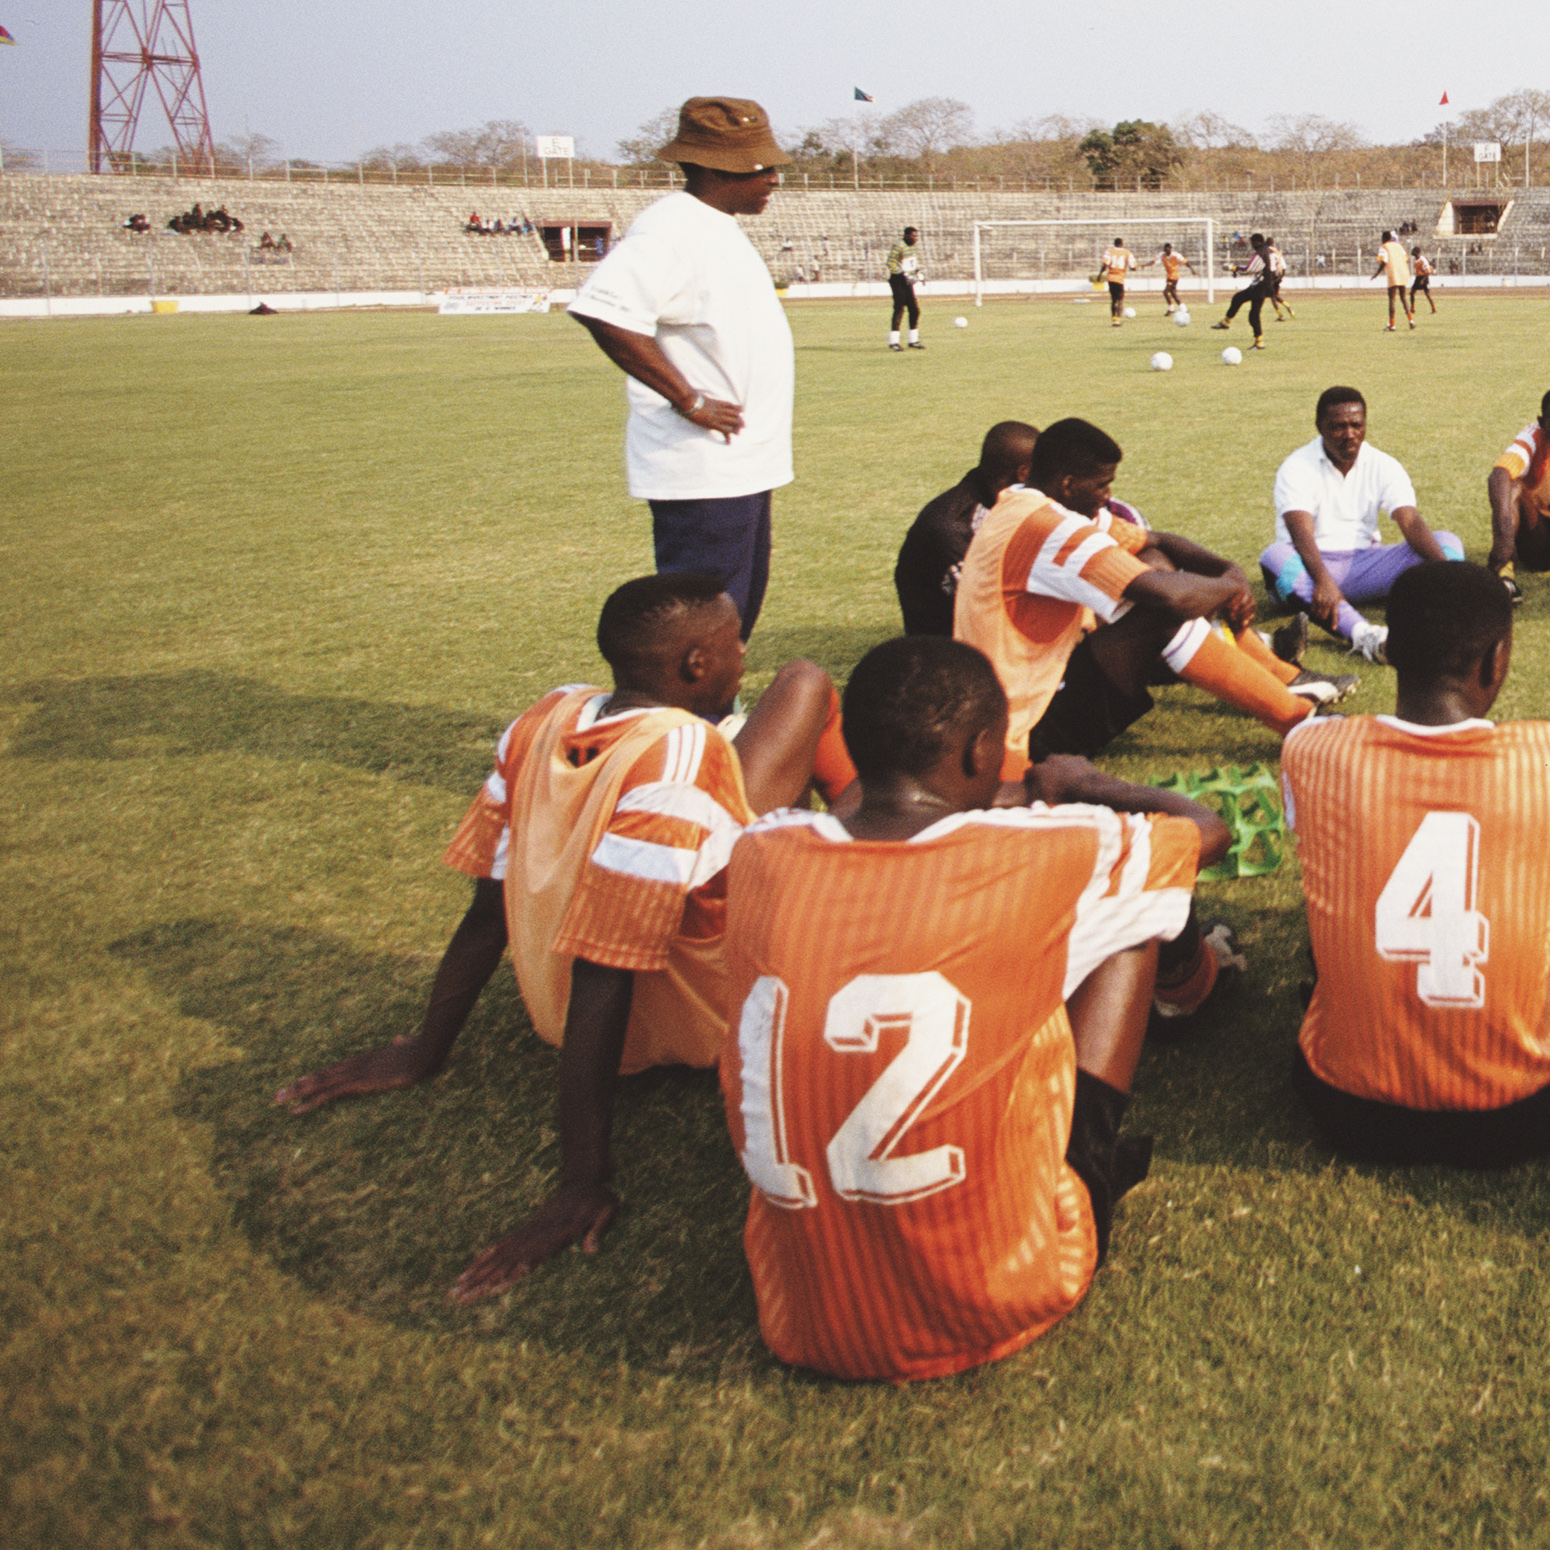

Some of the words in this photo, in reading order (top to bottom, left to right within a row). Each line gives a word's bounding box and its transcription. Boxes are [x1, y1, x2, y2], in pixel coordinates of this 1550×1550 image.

[552, 138, 559, 147] E
[544, 146, 570, 156] GATE
[1111, 254, 1126, 270] 14
[1375, 810, 1491, 1009] 4
[738, 971, 972, 1209] 12
